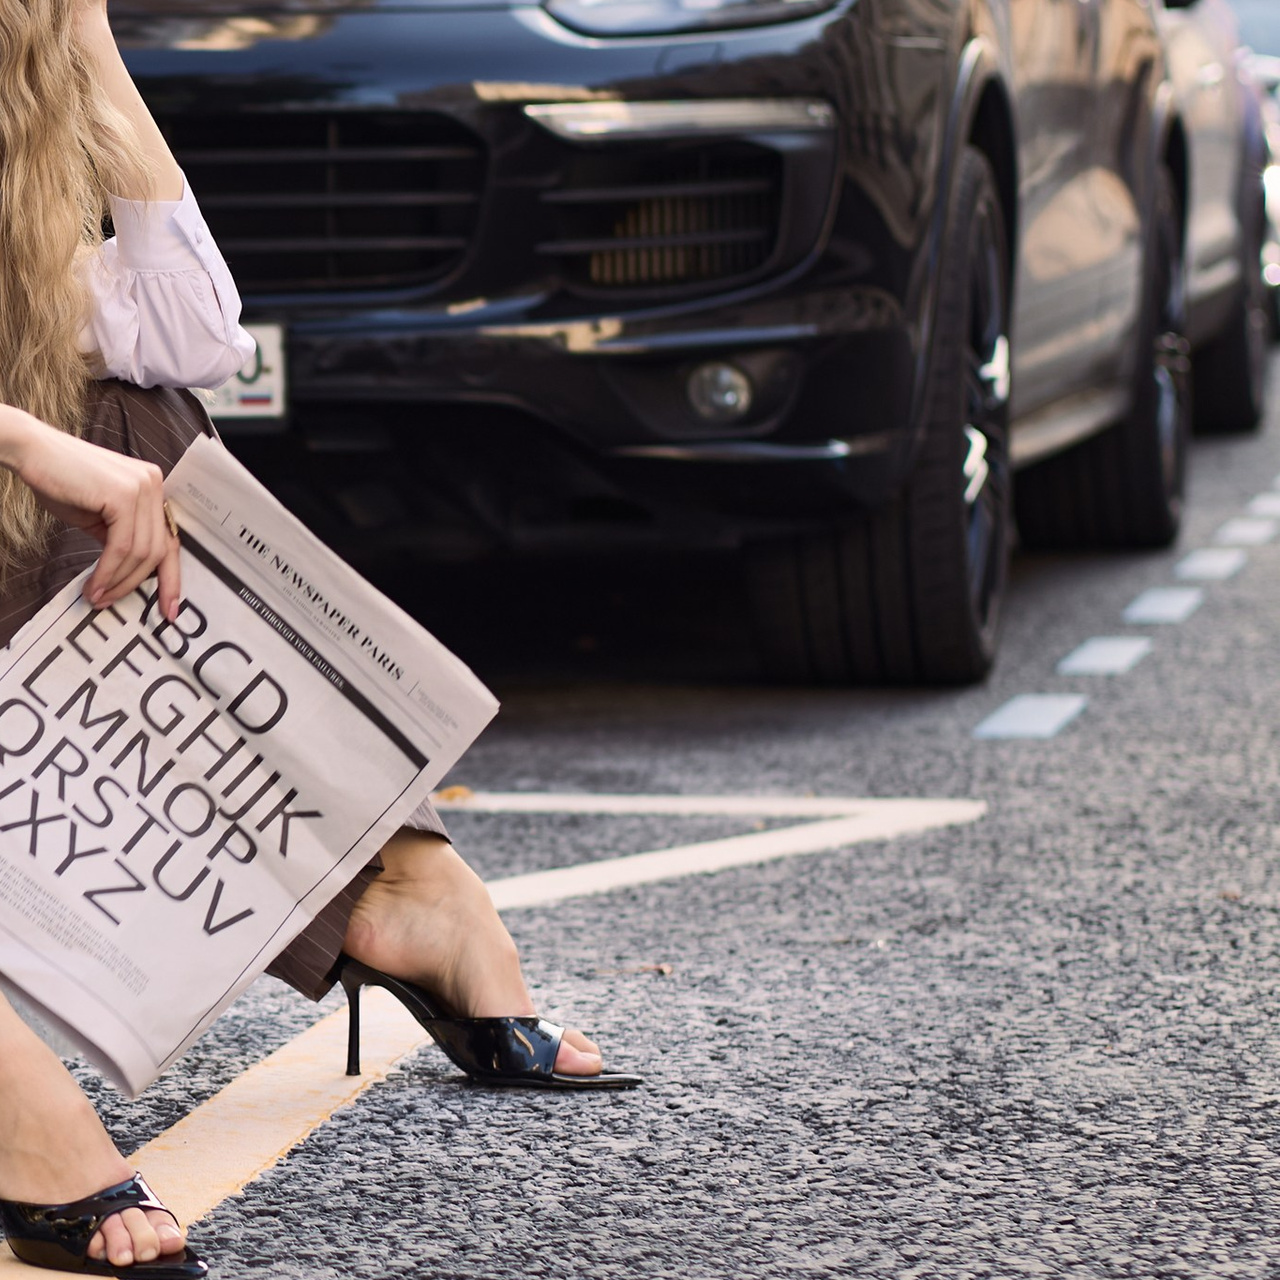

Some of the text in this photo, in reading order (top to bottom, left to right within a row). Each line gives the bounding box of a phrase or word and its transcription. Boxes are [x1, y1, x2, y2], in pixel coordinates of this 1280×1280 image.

[234, 523, 406, 681] THE NEWSPAPER PARIS
[236, 586, 264, 612] FIGHT
[258, 604, 296, 642] THROUGH
[291, 636, 316, 660] YOUR
[21, 645, 258, 864] LMNOP
[66, 600, 323, 858] EFGHIJK
